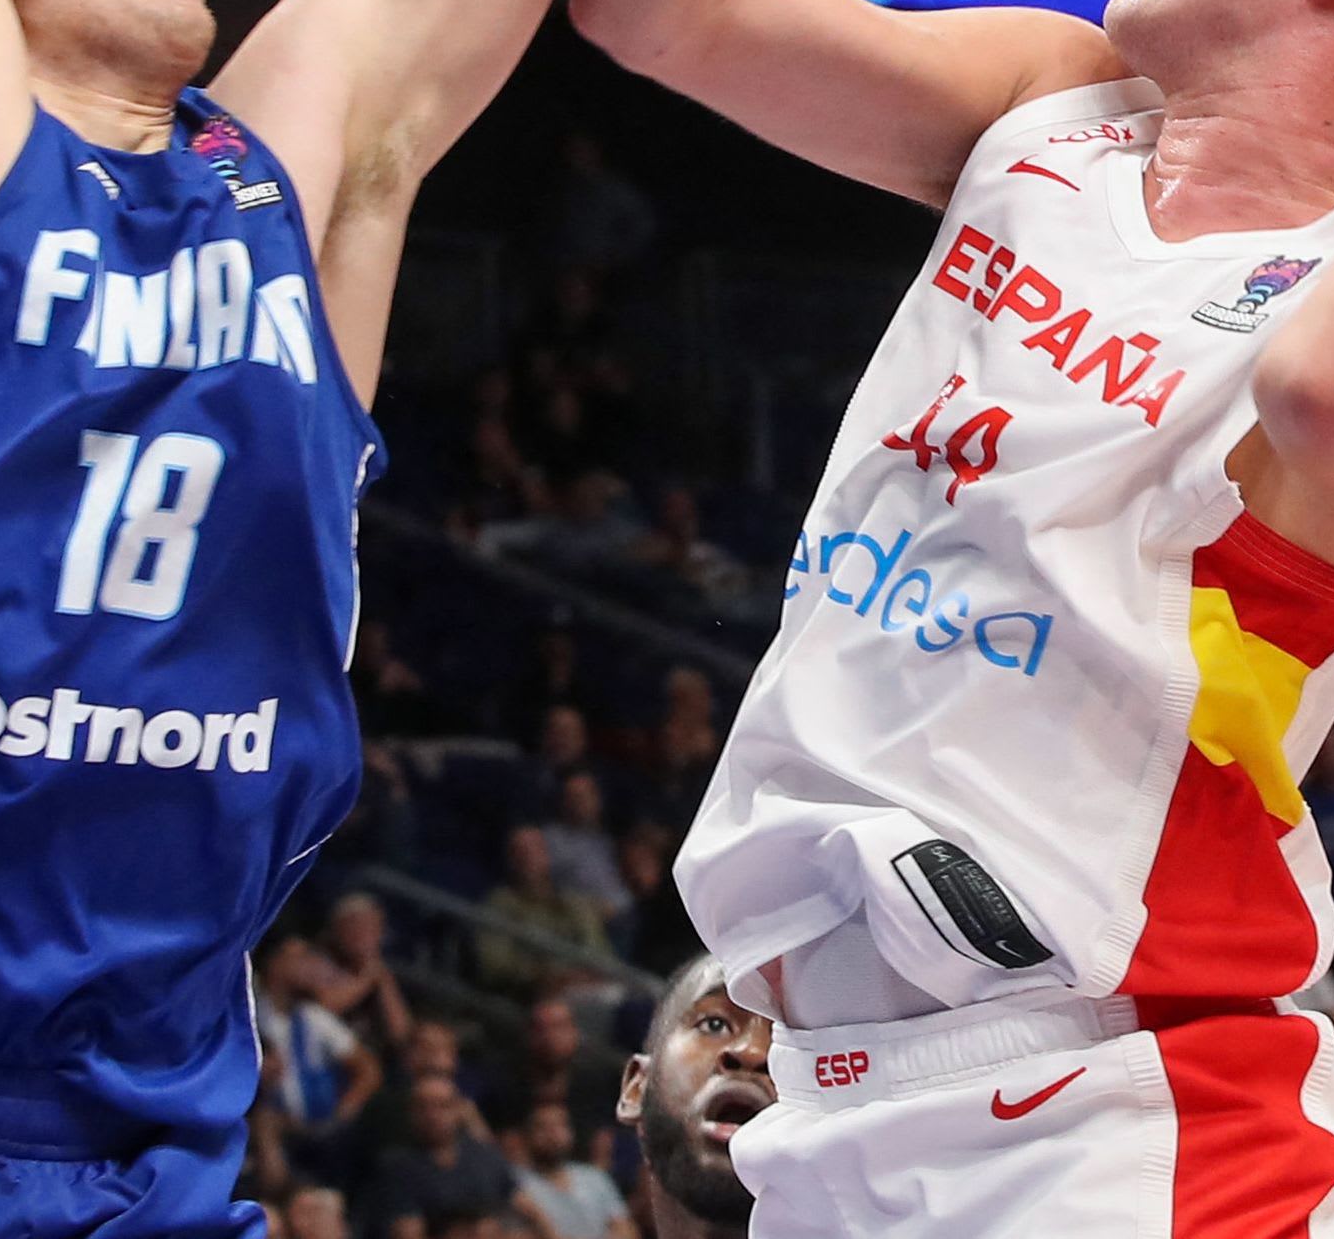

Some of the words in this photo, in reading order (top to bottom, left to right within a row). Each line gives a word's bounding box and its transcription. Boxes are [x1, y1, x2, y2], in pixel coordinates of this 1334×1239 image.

[931, 223, 1187, 428] ESPAÑA
[55, 430, 225, 622] 18
[814, 1050, 871, 1088] ESP
